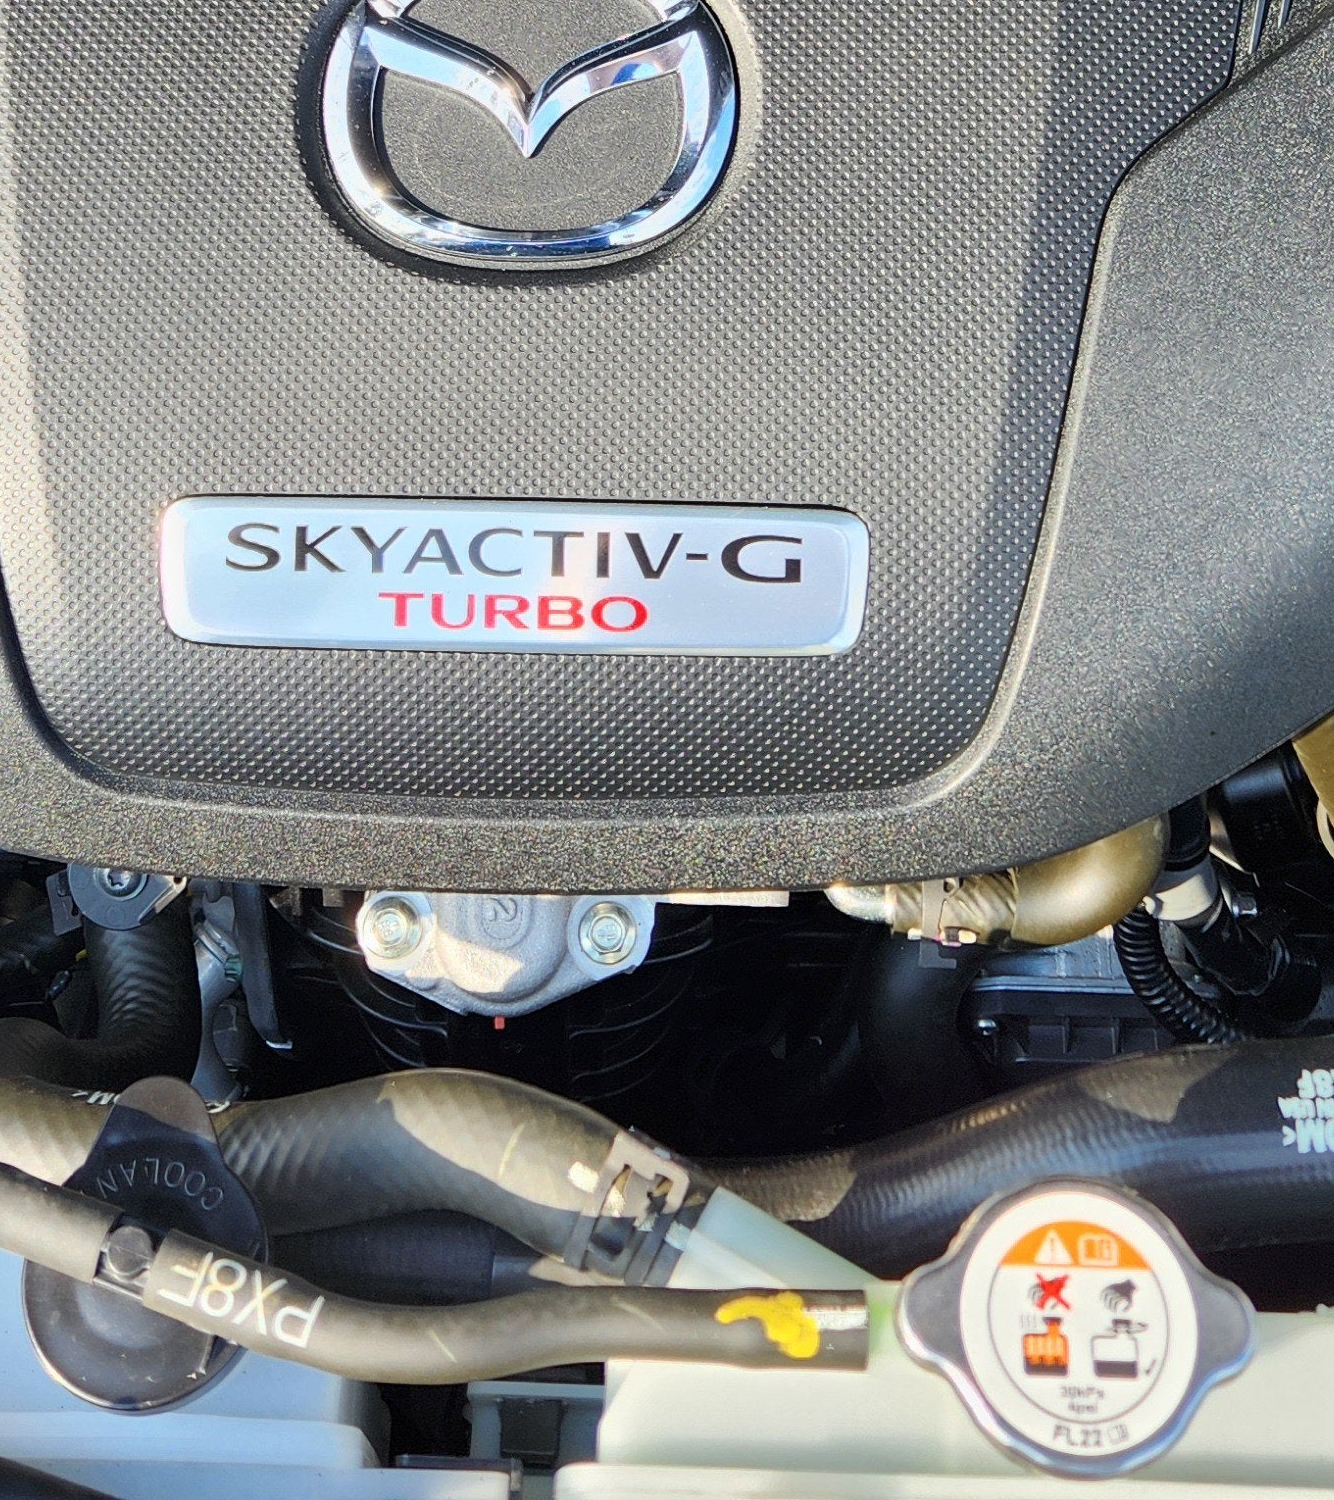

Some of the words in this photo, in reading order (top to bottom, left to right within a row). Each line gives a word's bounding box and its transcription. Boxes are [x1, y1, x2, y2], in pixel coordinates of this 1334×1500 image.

[224, 521, 803, 585] SKYACTIV-G
[378, 591, 650, 633] TURBO
[95, 1157, 224, 1211] COOLAN
[157, 1250, 327, 1349] PX8F
